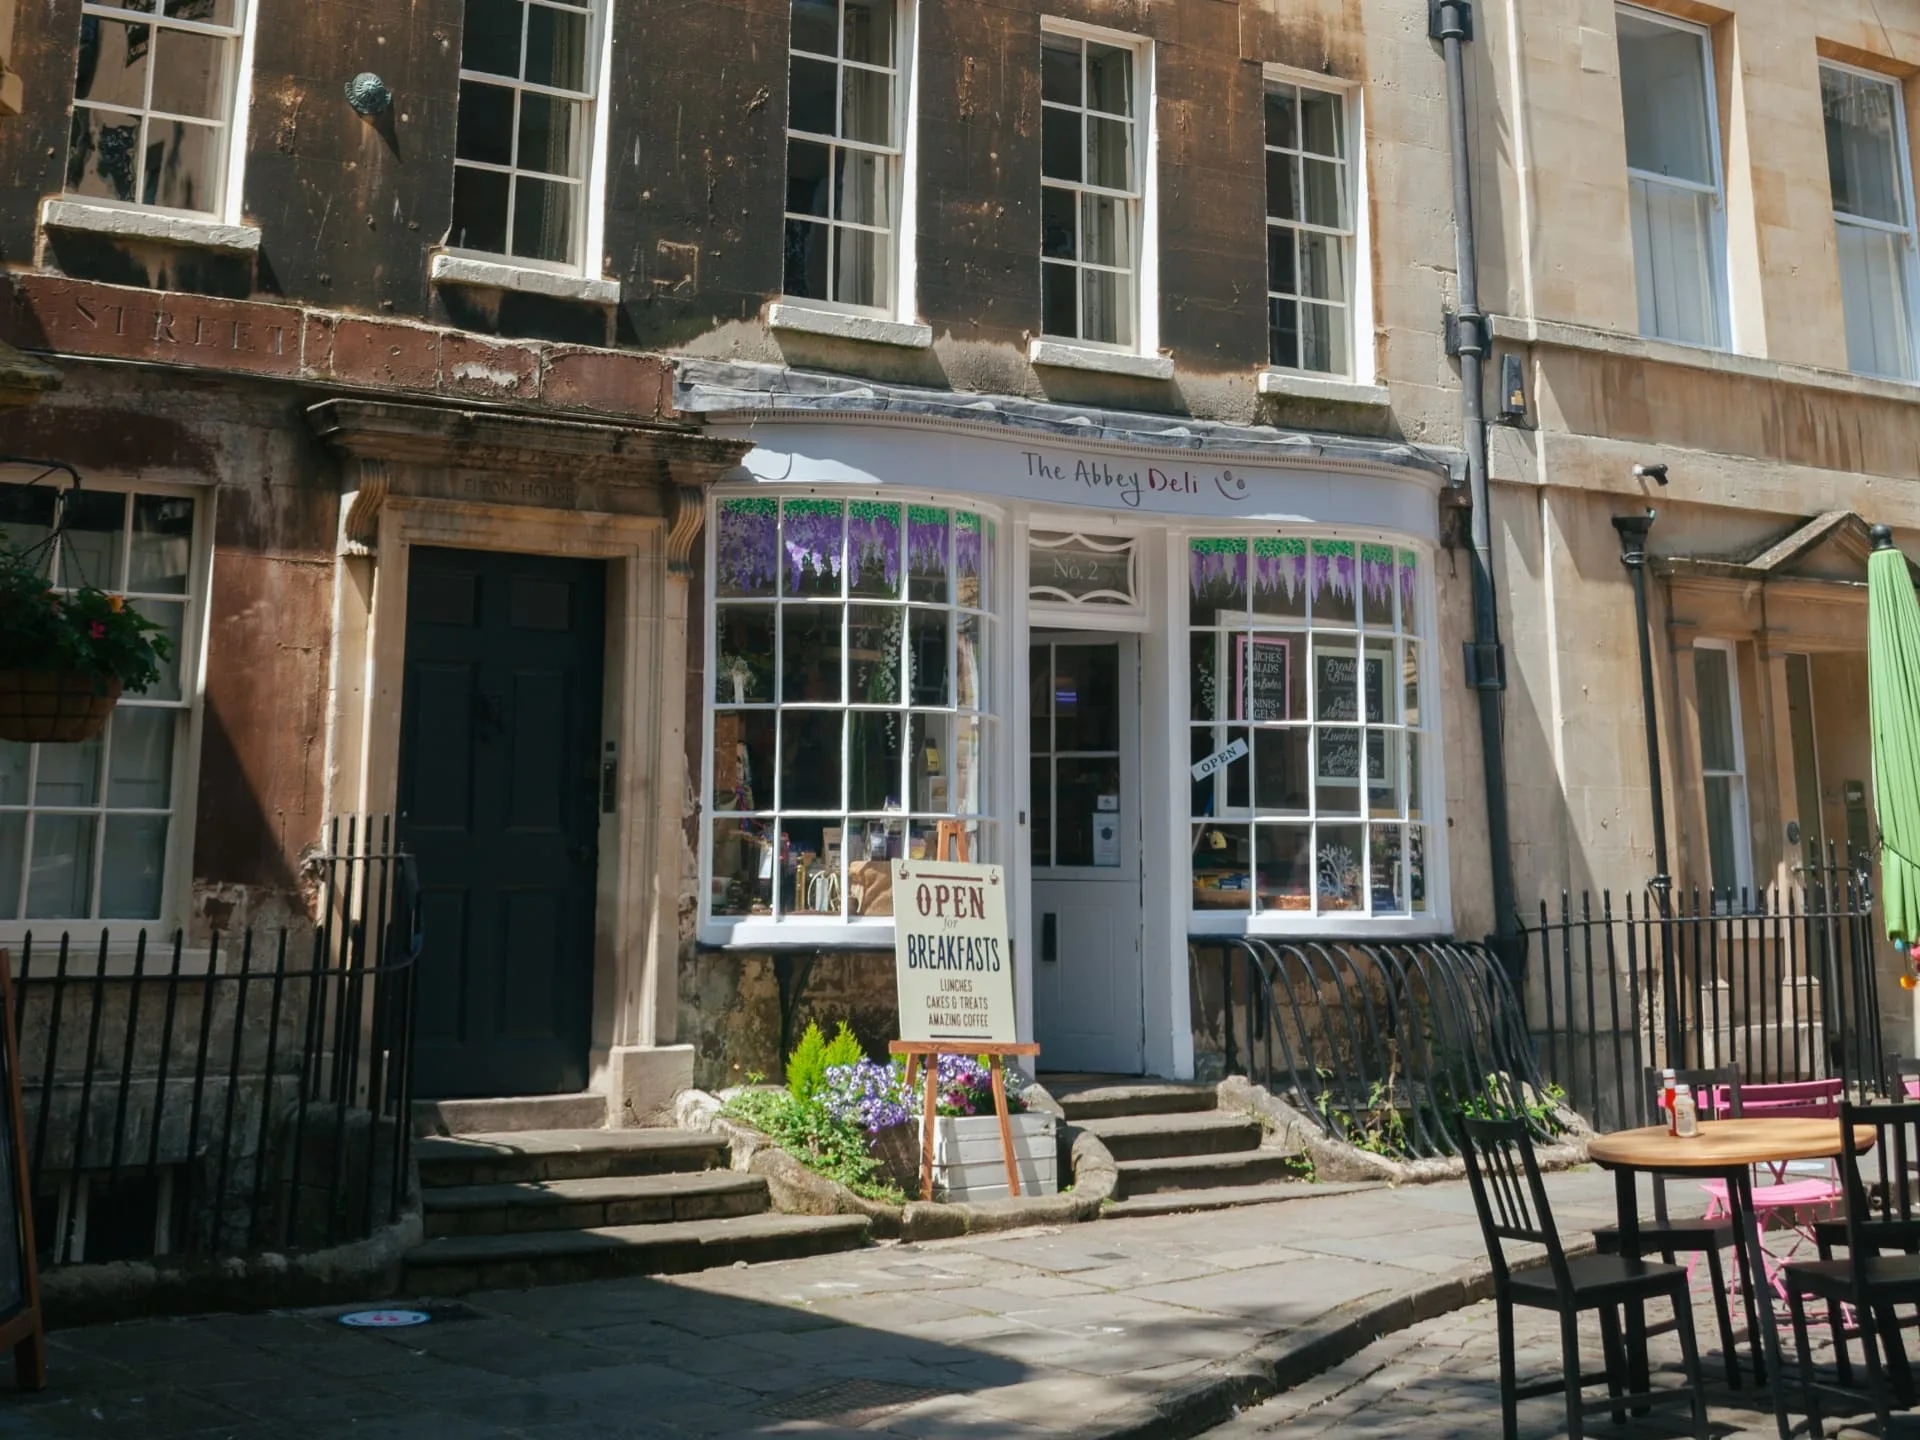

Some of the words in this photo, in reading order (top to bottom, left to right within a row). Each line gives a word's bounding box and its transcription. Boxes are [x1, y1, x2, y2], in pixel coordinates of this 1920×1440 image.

[75, 297, 298, 356] STREET
[1021, 451, 1066, 480] The
[1075, 459, 1145, 507] Abbey
[1149, 468, 1199, 494] Deli
[521, 483, 576, 501] HOUSE
[1053, 557, 1084, 580] No.
[1087, 563, 1099, 581] 2
[1201, 747, 1237, 773] OPEN
[916, 883, 986, 920] OPEN
[942, 916, 958, 932] for
[907, 933, 1000, 972] BREAKFASTS
[940, 978, 973, 993] LUNCHES
[926, 995, 950, 1010] CAKES
[959, 997, 989, 1011] TREATS
[928, 1012, 962, 1027] AMAZING
[963, 1013, 989, 1028] COFFEE
